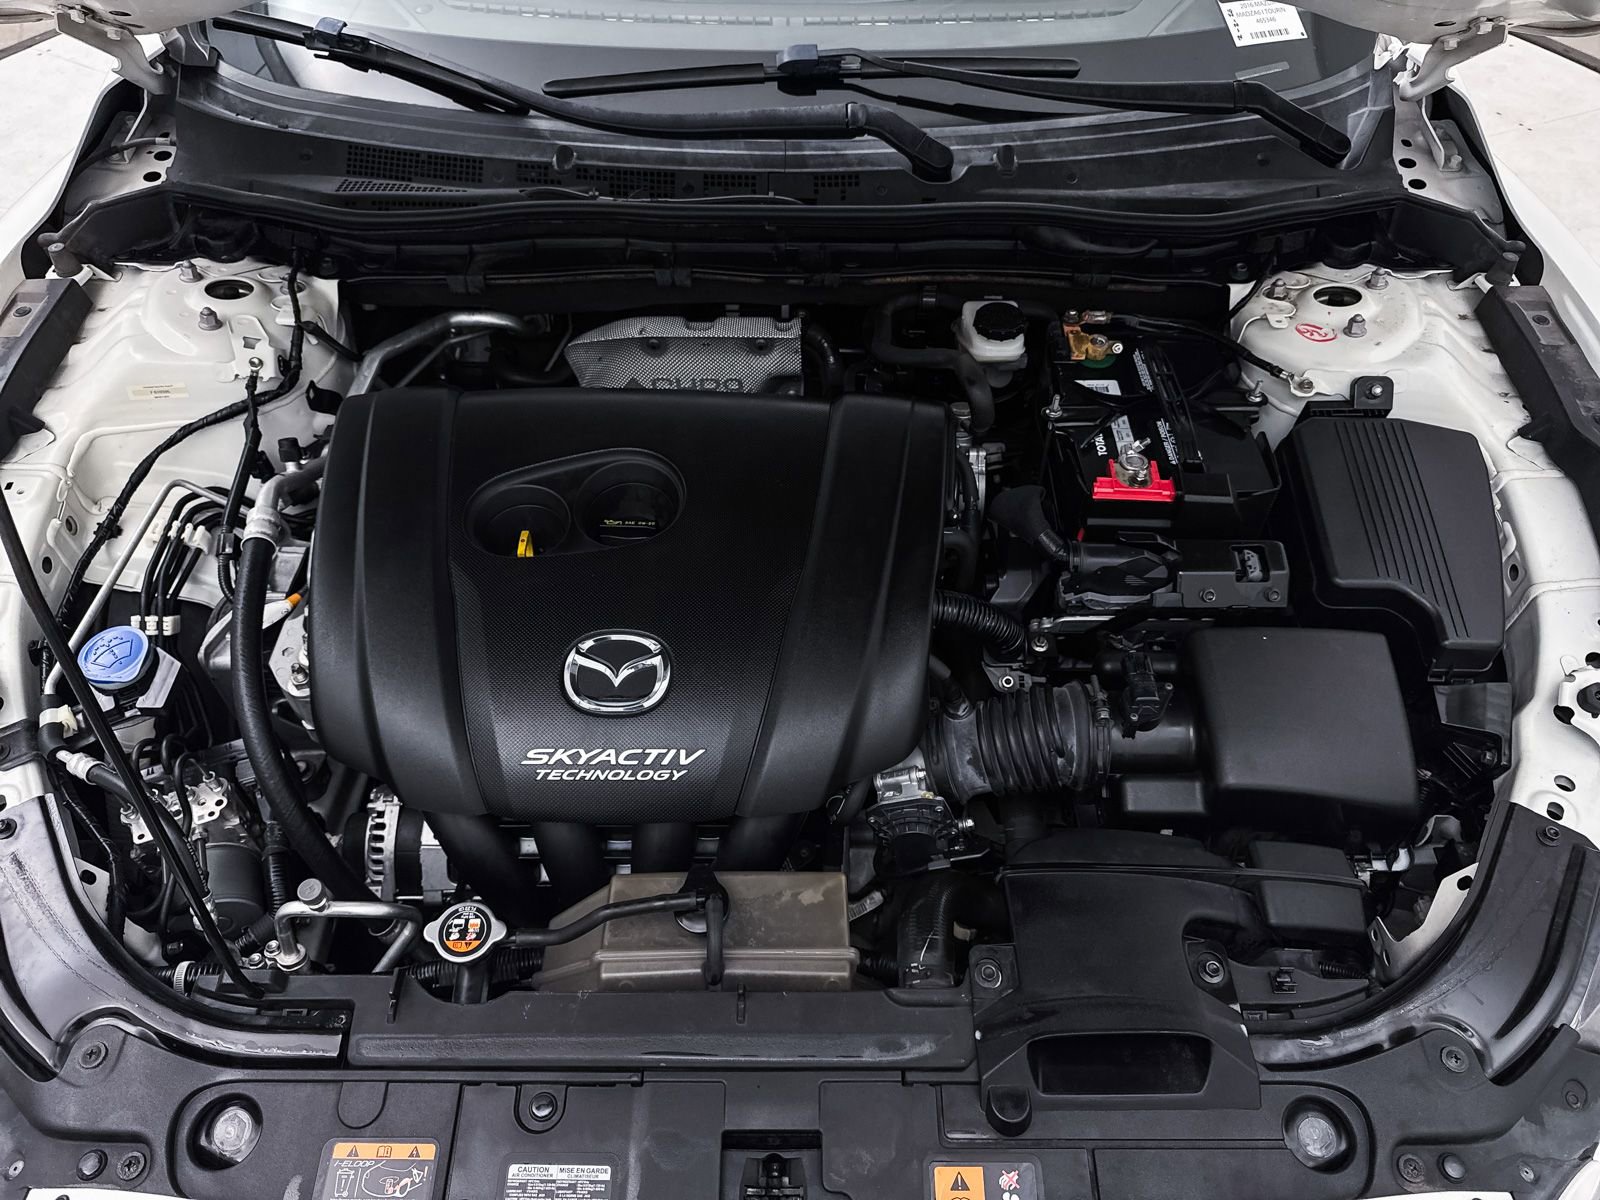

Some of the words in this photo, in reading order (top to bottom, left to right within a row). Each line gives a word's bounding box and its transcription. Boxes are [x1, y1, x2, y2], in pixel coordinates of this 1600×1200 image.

[521, 748, 706, 766] SKYACTIV
[535, 769, 688, 781] TECHNOLOGY
[585, 1167, 609, 1175] GARDE
